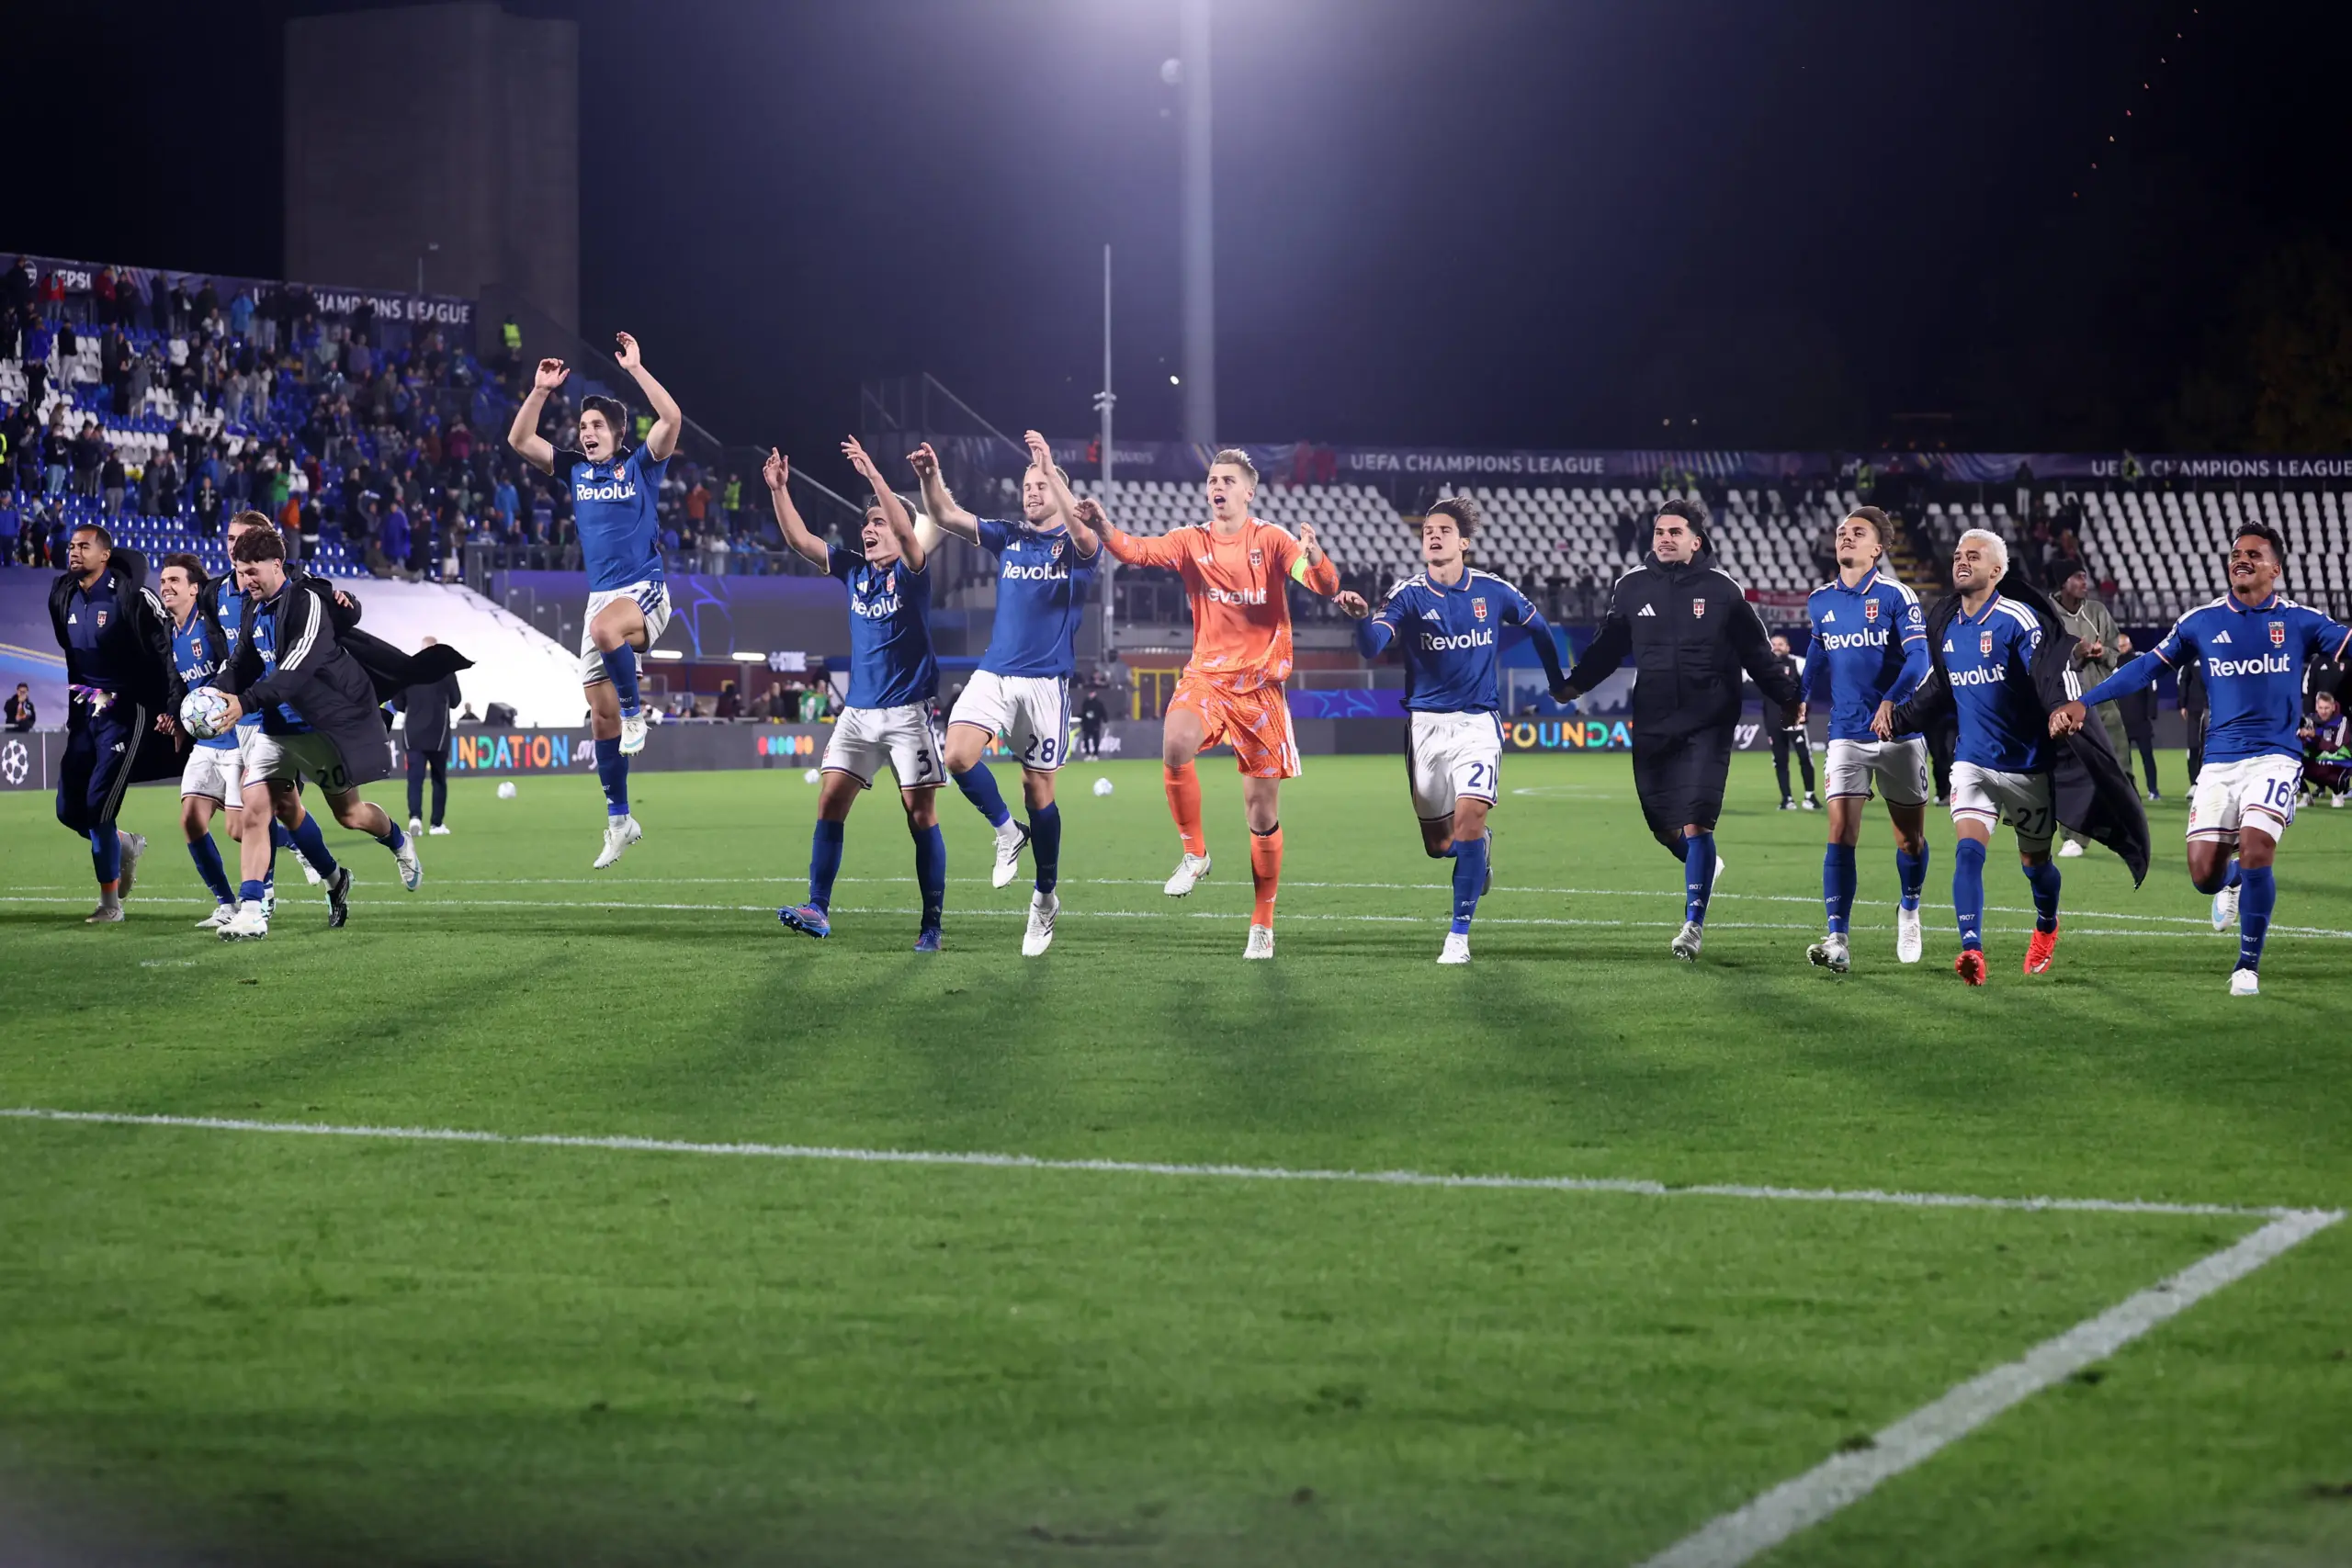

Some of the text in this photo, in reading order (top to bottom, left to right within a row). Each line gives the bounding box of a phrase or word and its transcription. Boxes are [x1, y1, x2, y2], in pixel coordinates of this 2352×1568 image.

[58, 268, 92, 290] EPSI
[314, 292, 469, 323] HAMPONS LEAGUE
[1351, 454, 1605, 474] UEFA CHAMPIONS LEAGUE
[576, 482, 636, 501] Revolut
[1002, 560, 1069, 580] Revolut
[851, 592, 903, 618] Revolut
[1420, 627, 1493, 650] Revolut
[1822, 627, 1889, 651] Revolut
[179, 660, 216, 682] evolut
[1949, 663, 2006, 686] evolut
[2208, 653, 2290, 677] Revolut
[1024, 734, 1056, 762] 28
[917, 750, 933, 776] 3
[316, 764, 345, 790] 20
[1467, 762, 1494, 791] 21
[1919, 765, 1928, 792] 8
[2264, 778, 2290, 807] 16
[2017, 807, 2048, 835] 27
